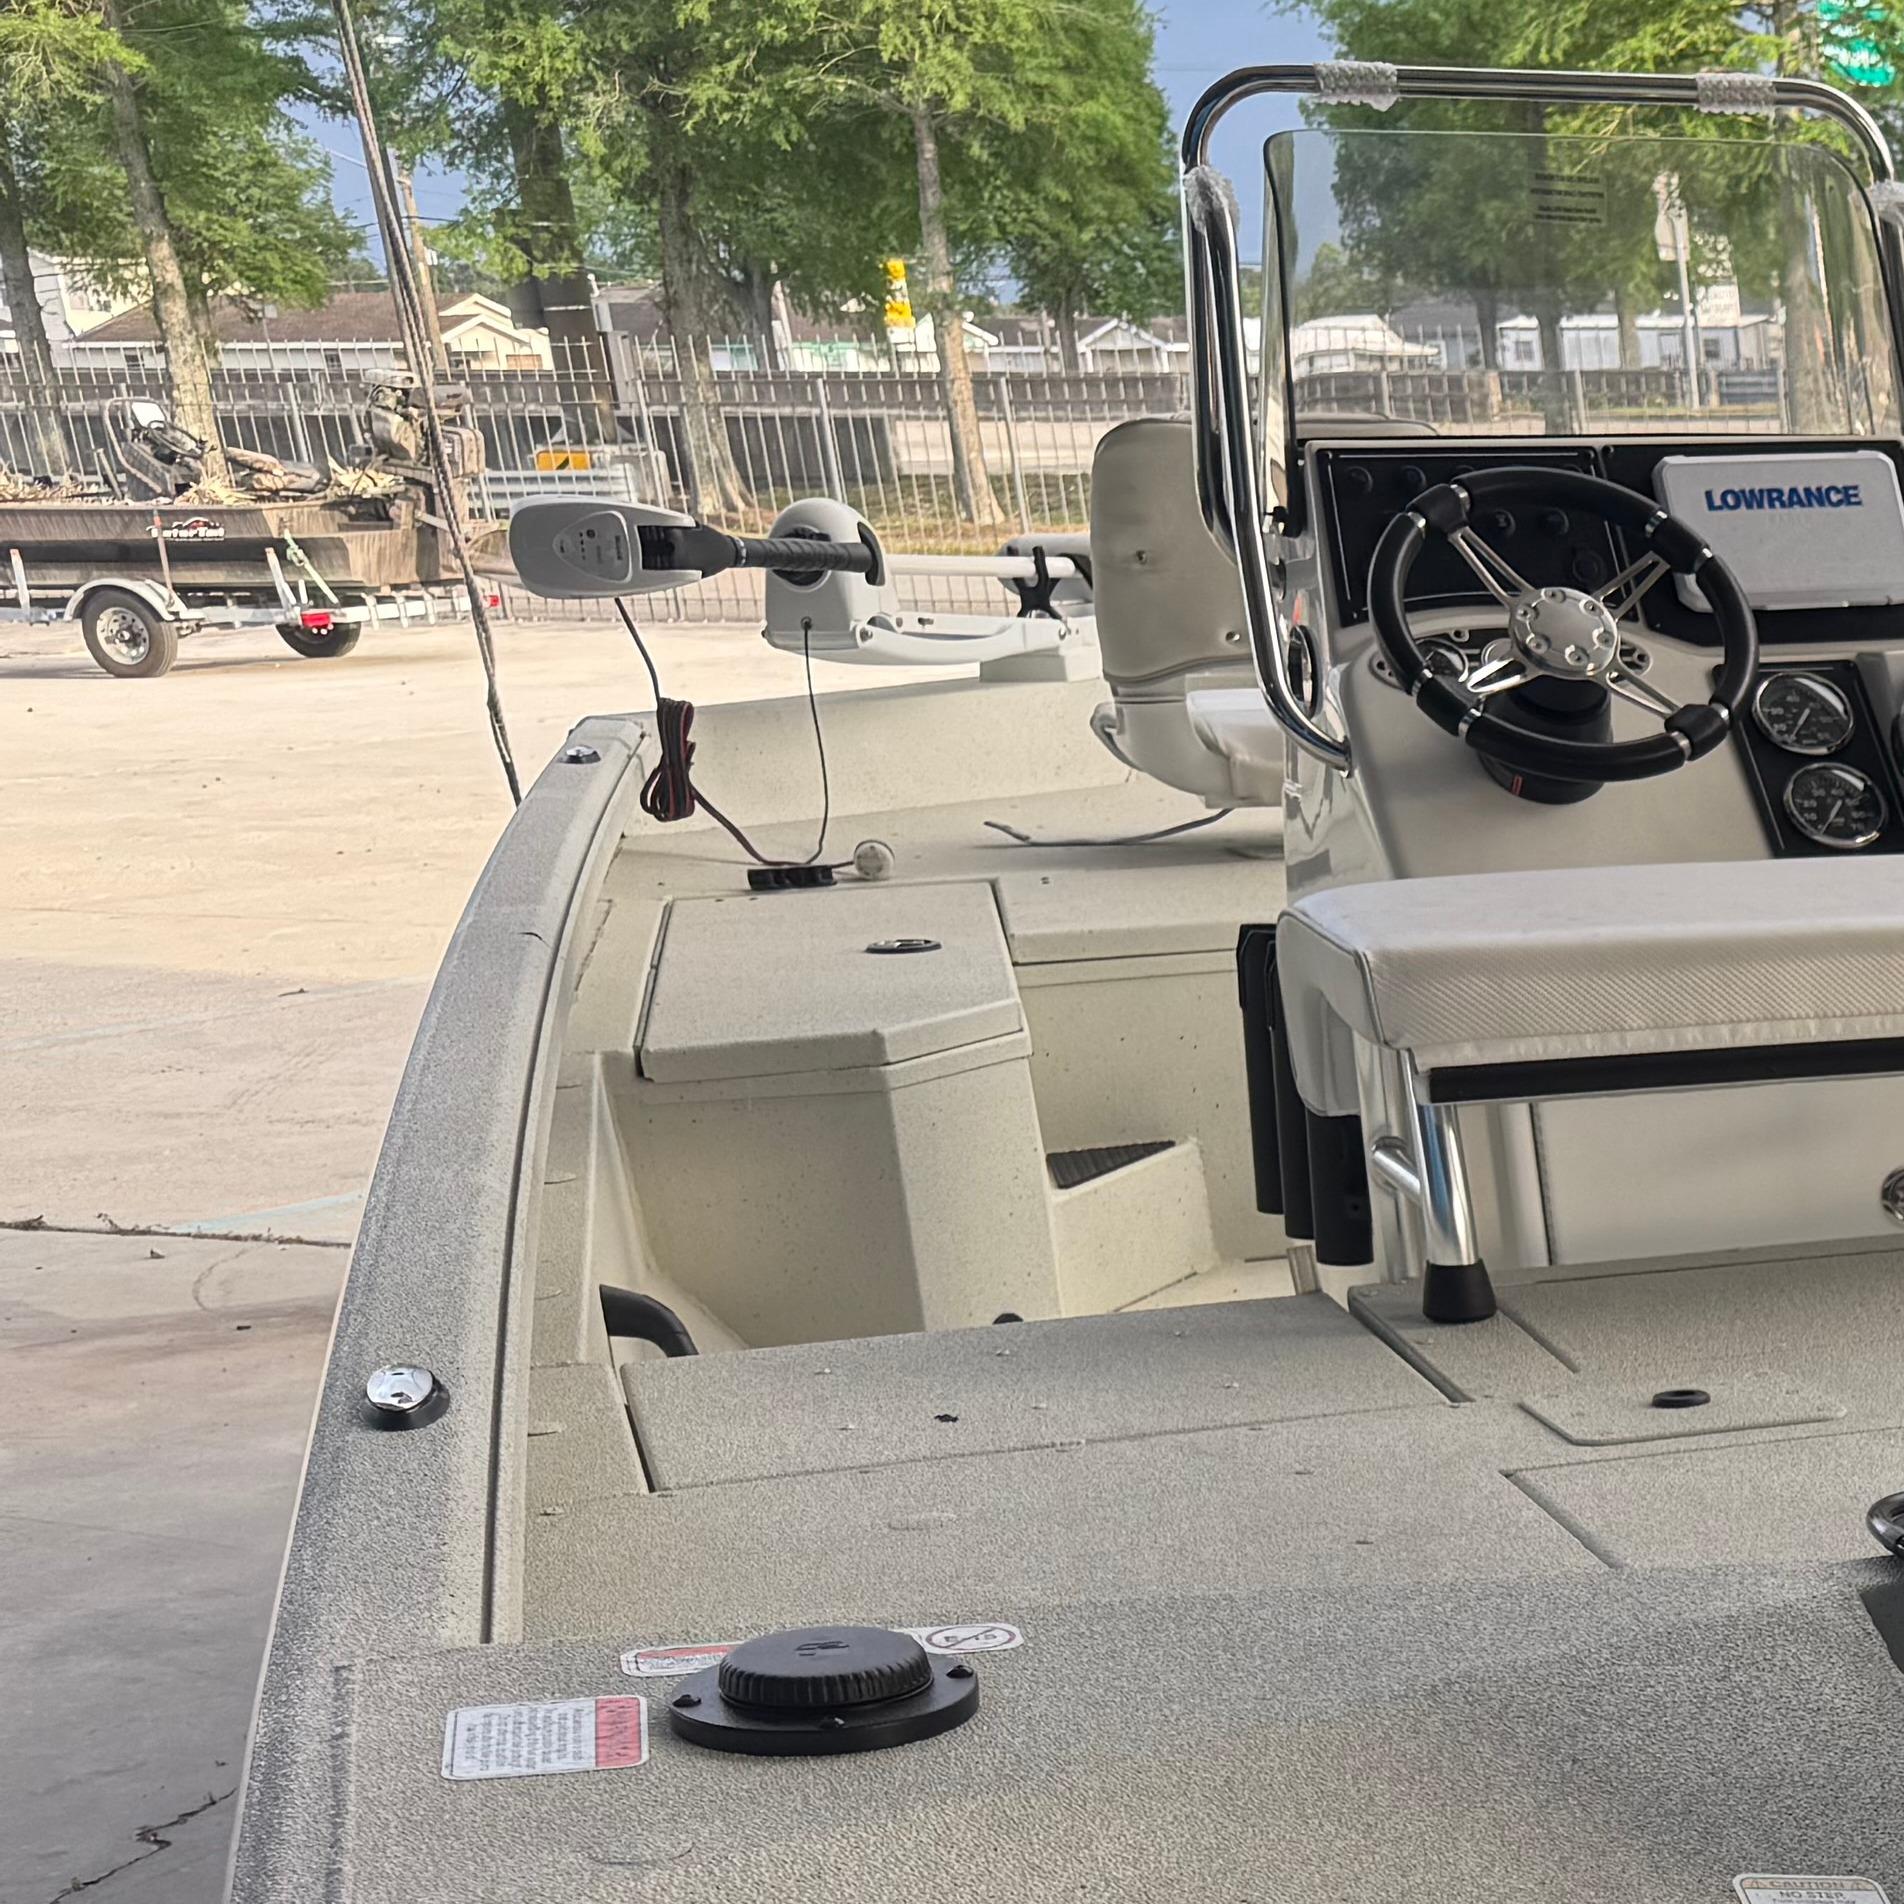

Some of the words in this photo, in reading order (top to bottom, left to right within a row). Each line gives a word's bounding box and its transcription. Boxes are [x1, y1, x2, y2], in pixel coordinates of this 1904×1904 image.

[1705, 485, 1862, 512] LOWRANCE
[1769, 1879, 1843, 1889] CAUTION
[1779, 1890, 1801, 1898] NO
